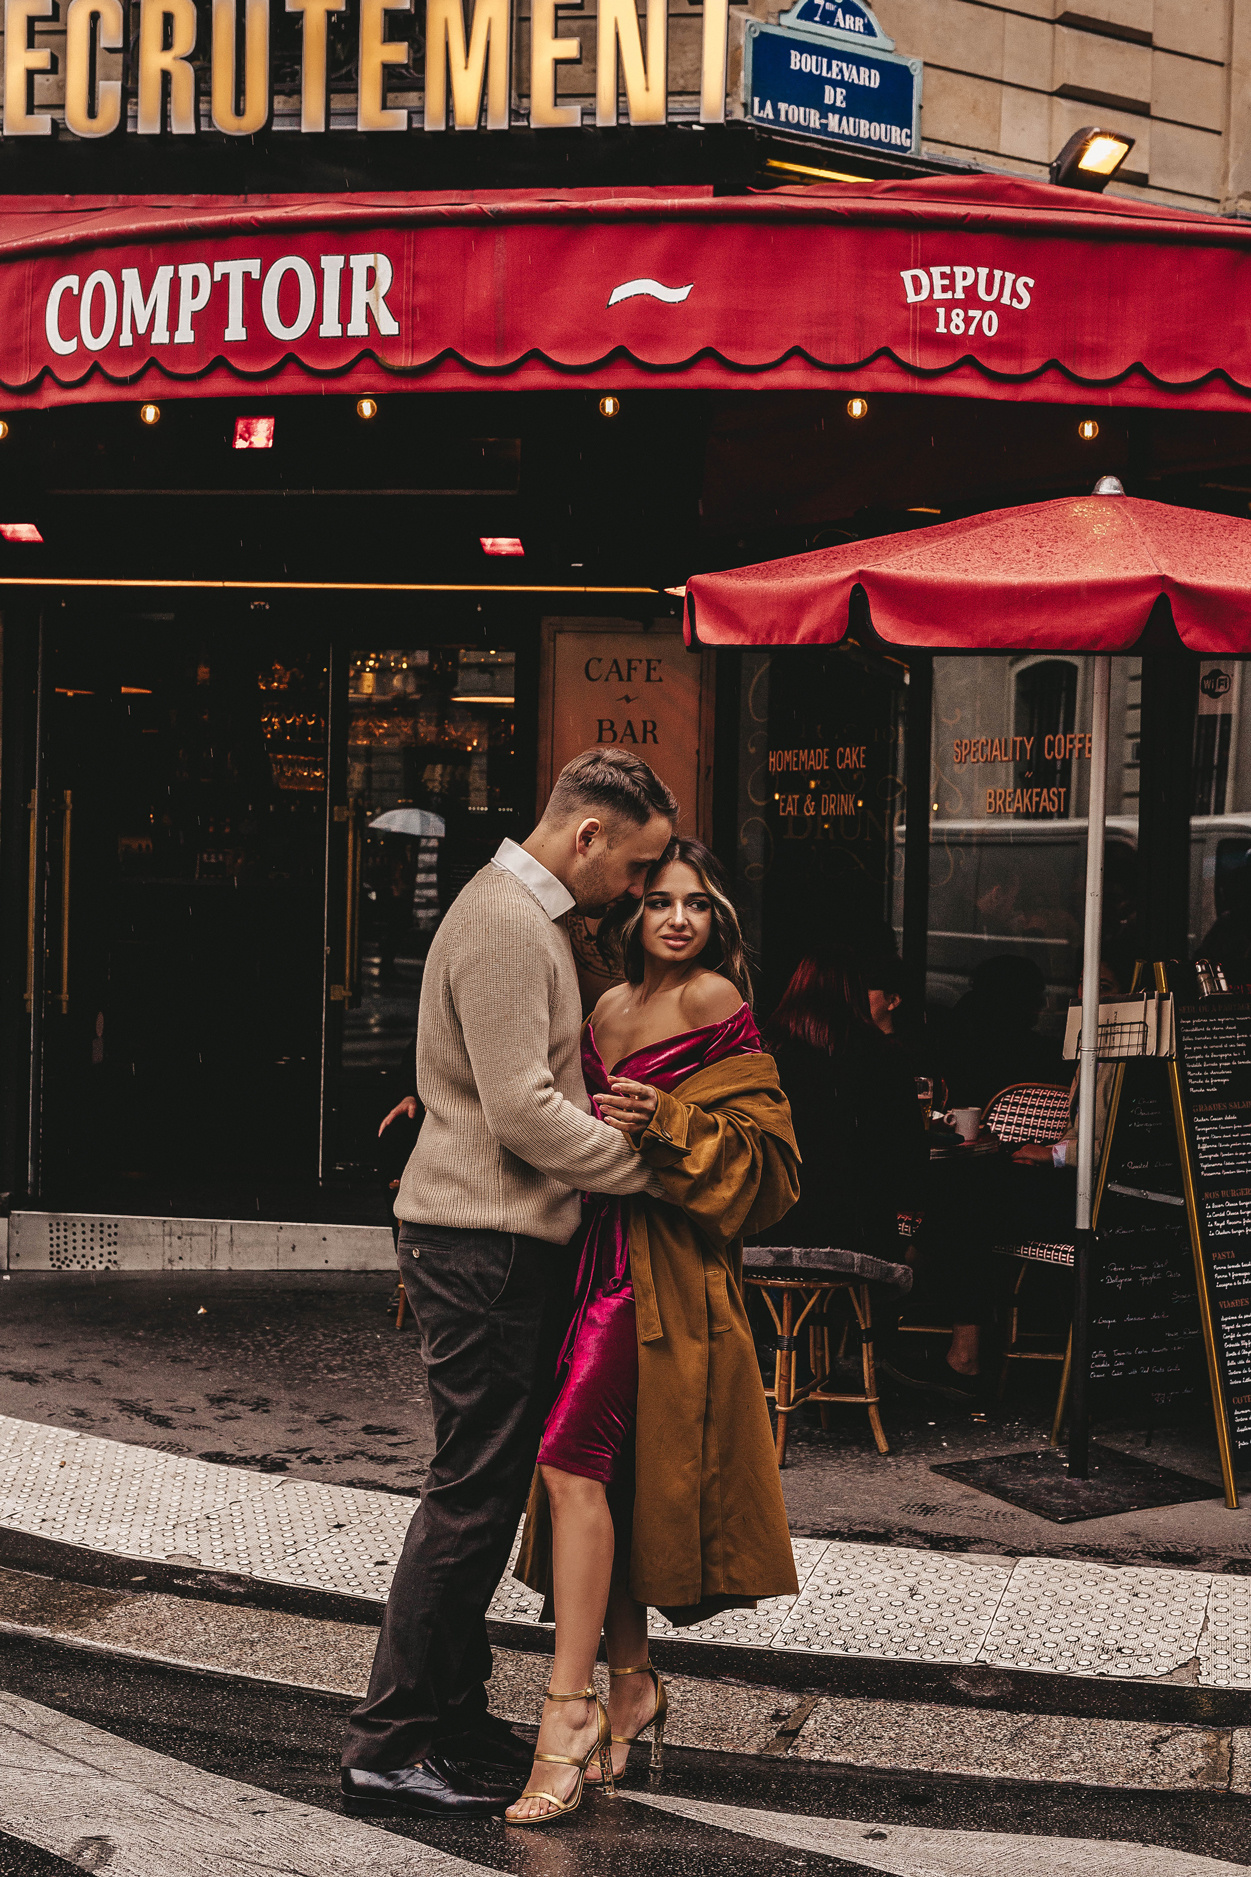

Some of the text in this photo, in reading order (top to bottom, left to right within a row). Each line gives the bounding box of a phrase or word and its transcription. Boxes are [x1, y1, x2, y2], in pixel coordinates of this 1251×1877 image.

[789, 49, 881, 89] BOULEVARD
[823, 84, 847, 108] DE
[753, 96, 911, 147] LA TOUR-MAUBOURG
[900, 265, 1035, 310] DEPUIS
[45, 252, 400, 357] COMPTOIR
[935, 307, 999, 337] 1870
[584, 657, 663, 683] CAFE
[595, 718, 659, 745] BAR
[769, 746, 867, 772] HOMEMADE CAKE
[953, 736, 1034, 764] SPECIALITY
[779, 793, 856, 816] EAT & DRINK
[986, 787, 1067, 814] BREAKFAST
[1212, 1250, 1236, 1261] PASTA
[1218, 1297, 1250, 1309] VIANDES
